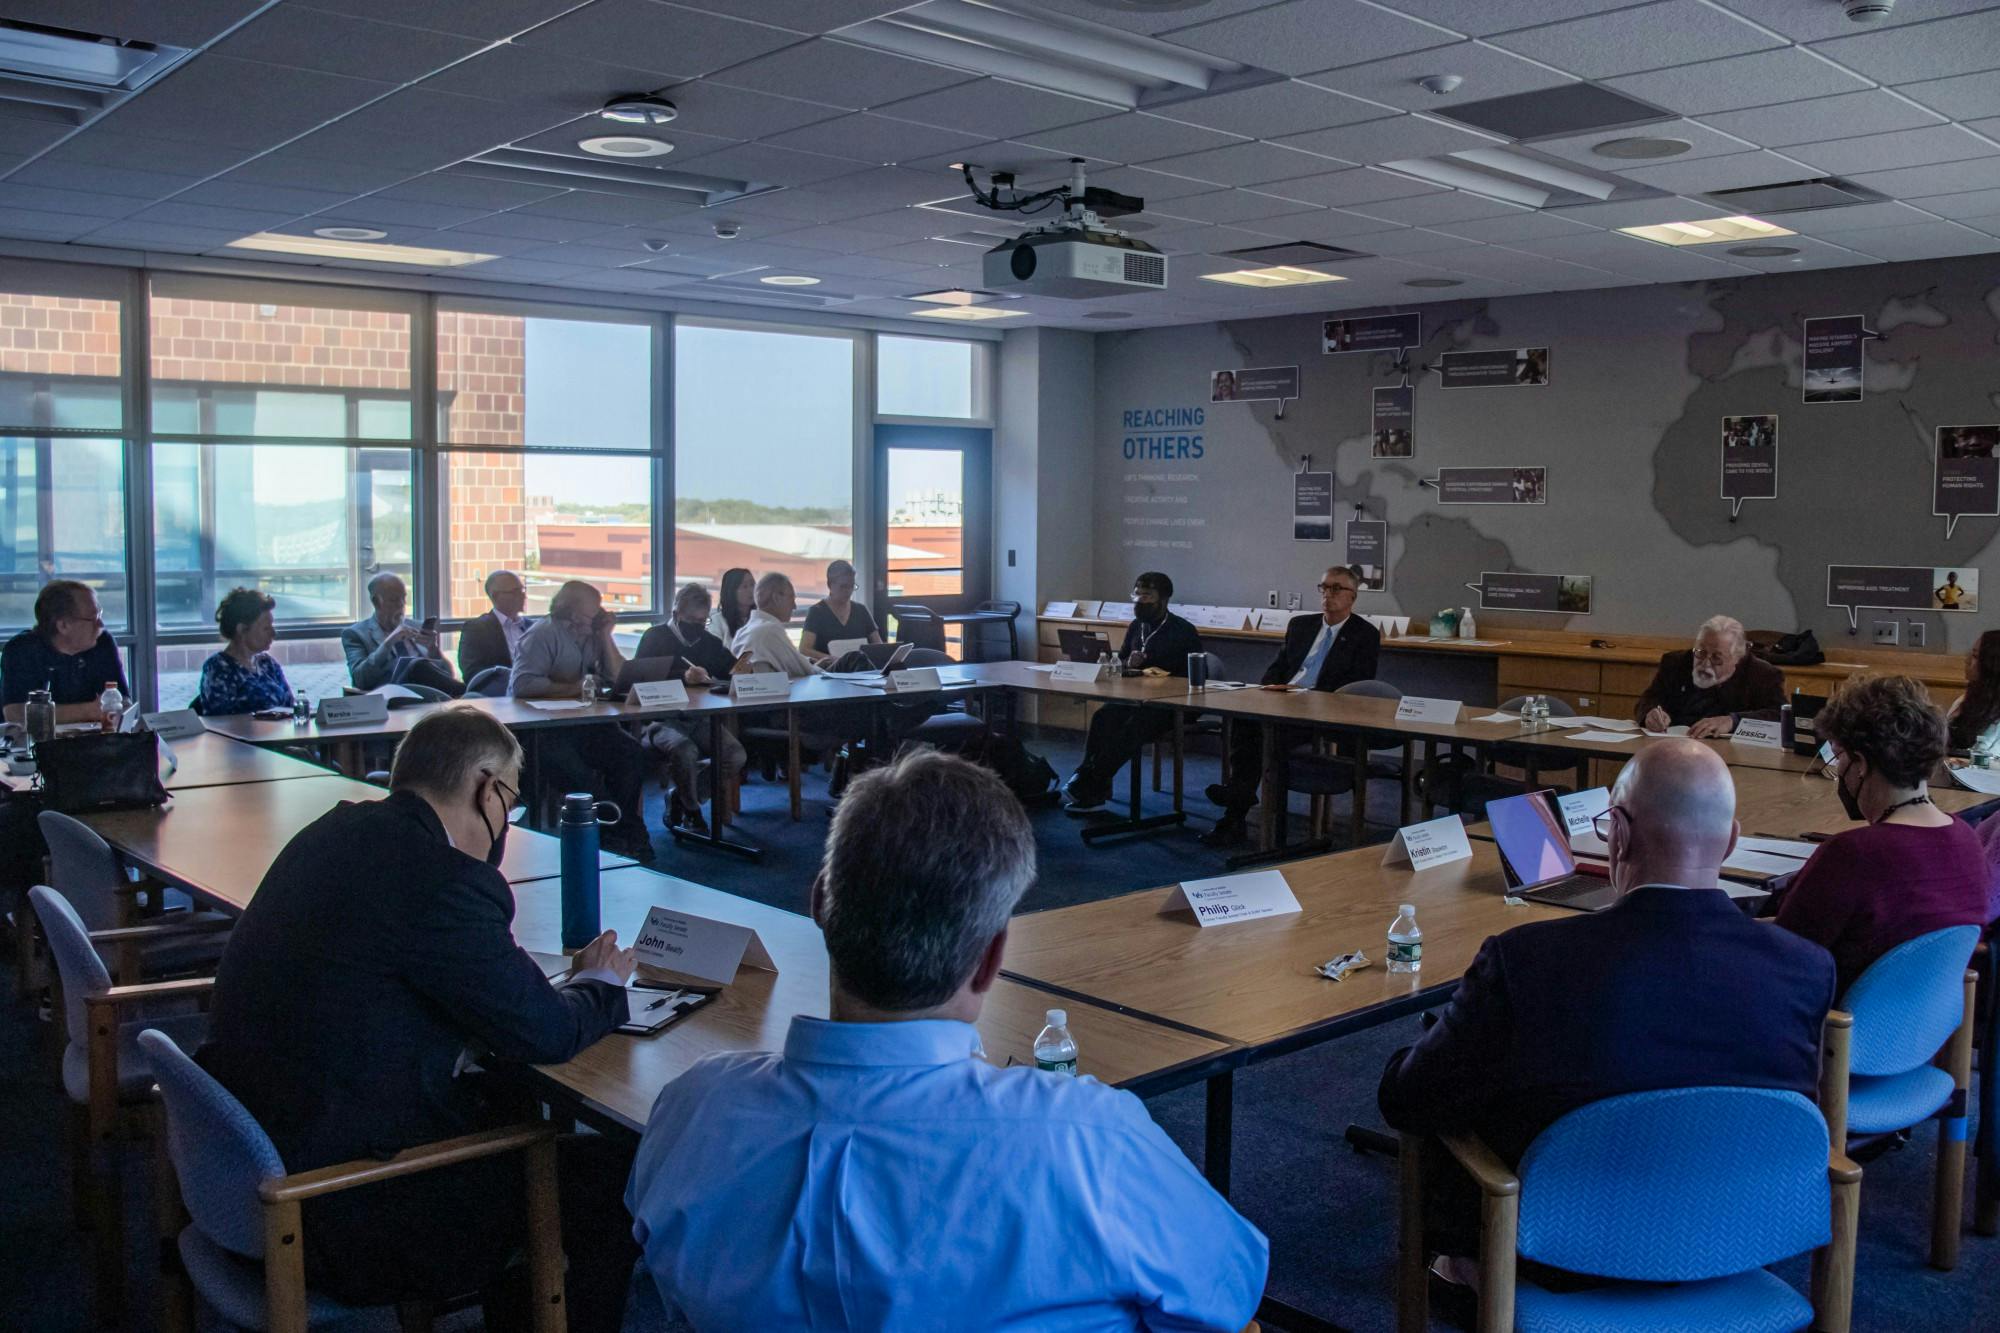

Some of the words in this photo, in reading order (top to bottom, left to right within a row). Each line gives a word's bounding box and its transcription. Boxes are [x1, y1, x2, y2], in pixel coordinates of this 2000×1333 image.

[1123, 408, 1205, 428] REACHING
[1123, 436, 1205, 460] OTHERS
[1736, 728, 1767, 739] Jessica
[1410, 846, 1432, 859] Kristin
[1199, 904, 1230, 916] Philip
[640, 934, 665, 951] John
